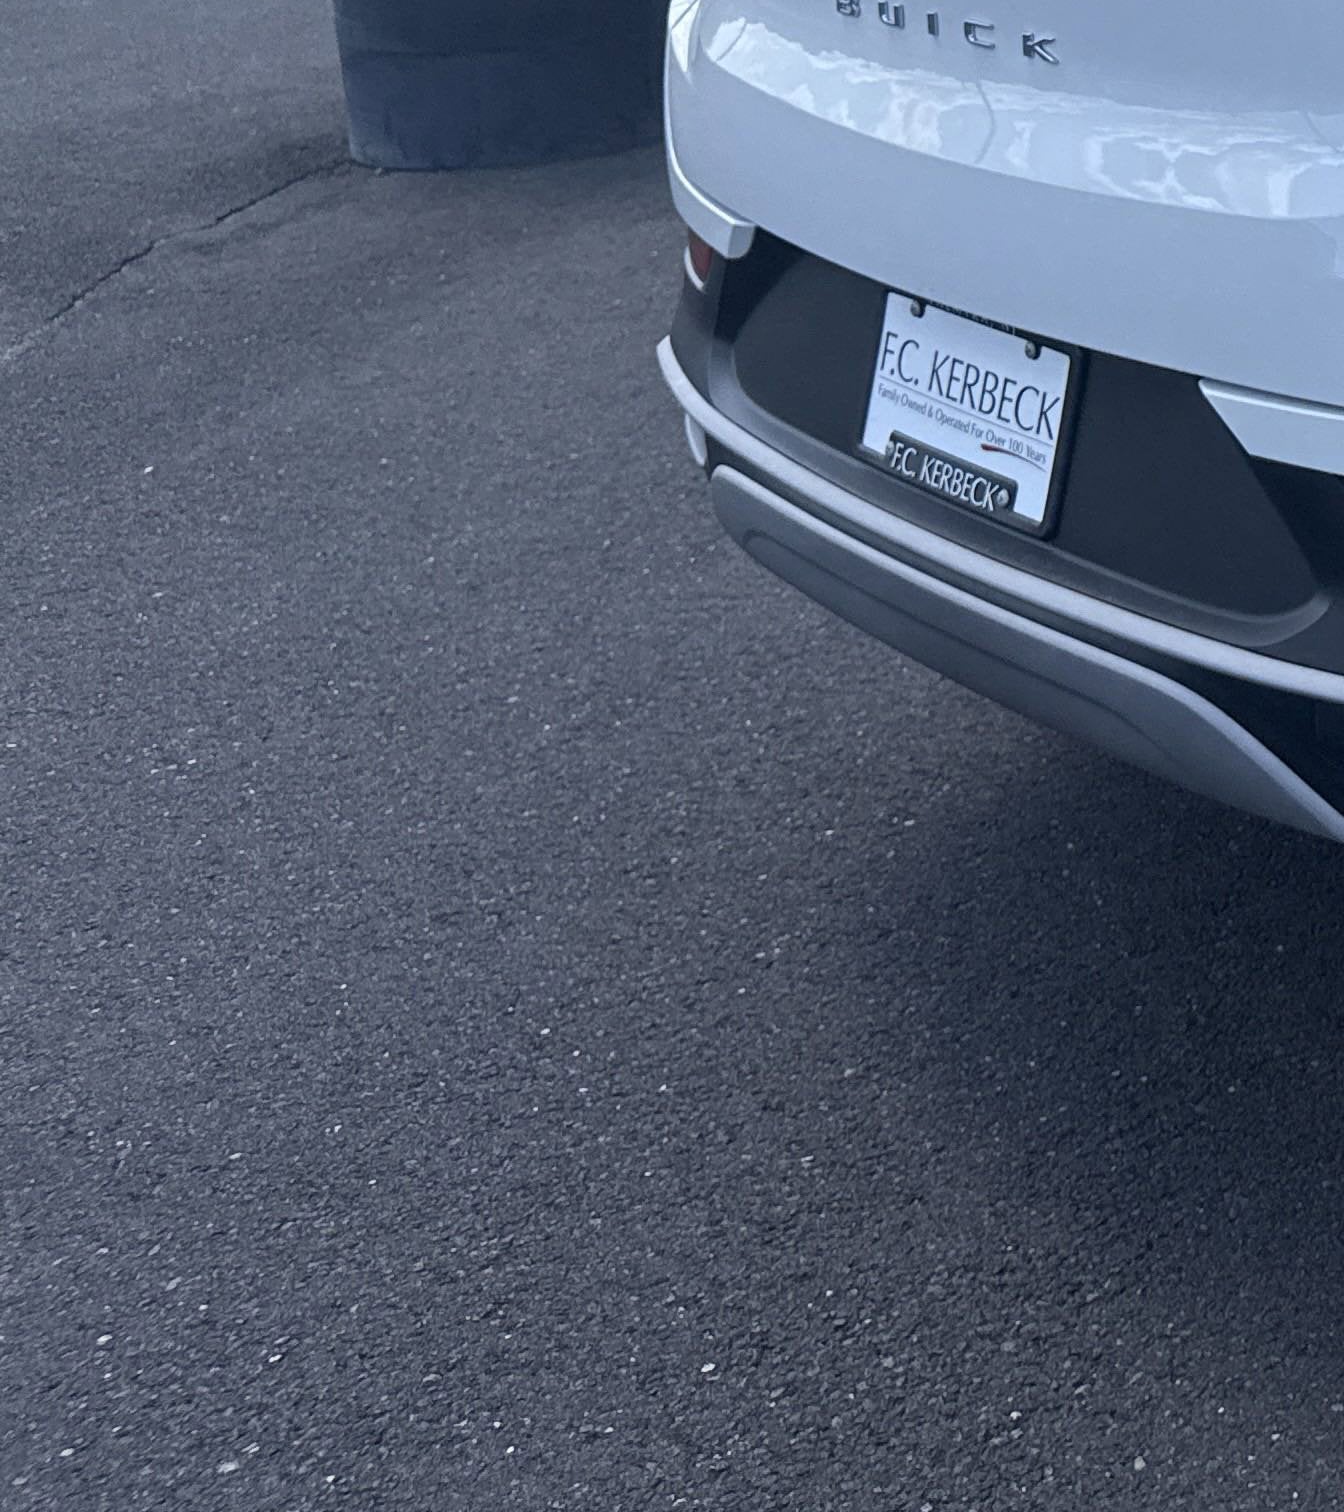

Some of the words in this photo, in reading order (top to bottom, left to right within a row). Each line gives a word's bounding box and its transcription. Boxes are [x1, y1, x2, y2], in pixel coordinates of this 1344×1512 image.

[880, 331, 920, 386] F.C.
[928, 350, 1060, 441] KERBECK
[901, 393, 928, 416] Owned
[935, 408, 971, 435] Operated
[970, 421, 984, 440] For
[985, 428, 1007, 447] Over
[1008, 437, 1024, 455] 100
[1026, 445, 1048, 465] Years
[890, 442, 917, 477] F.C.
[919, 455, 999, 512] KERBECK
